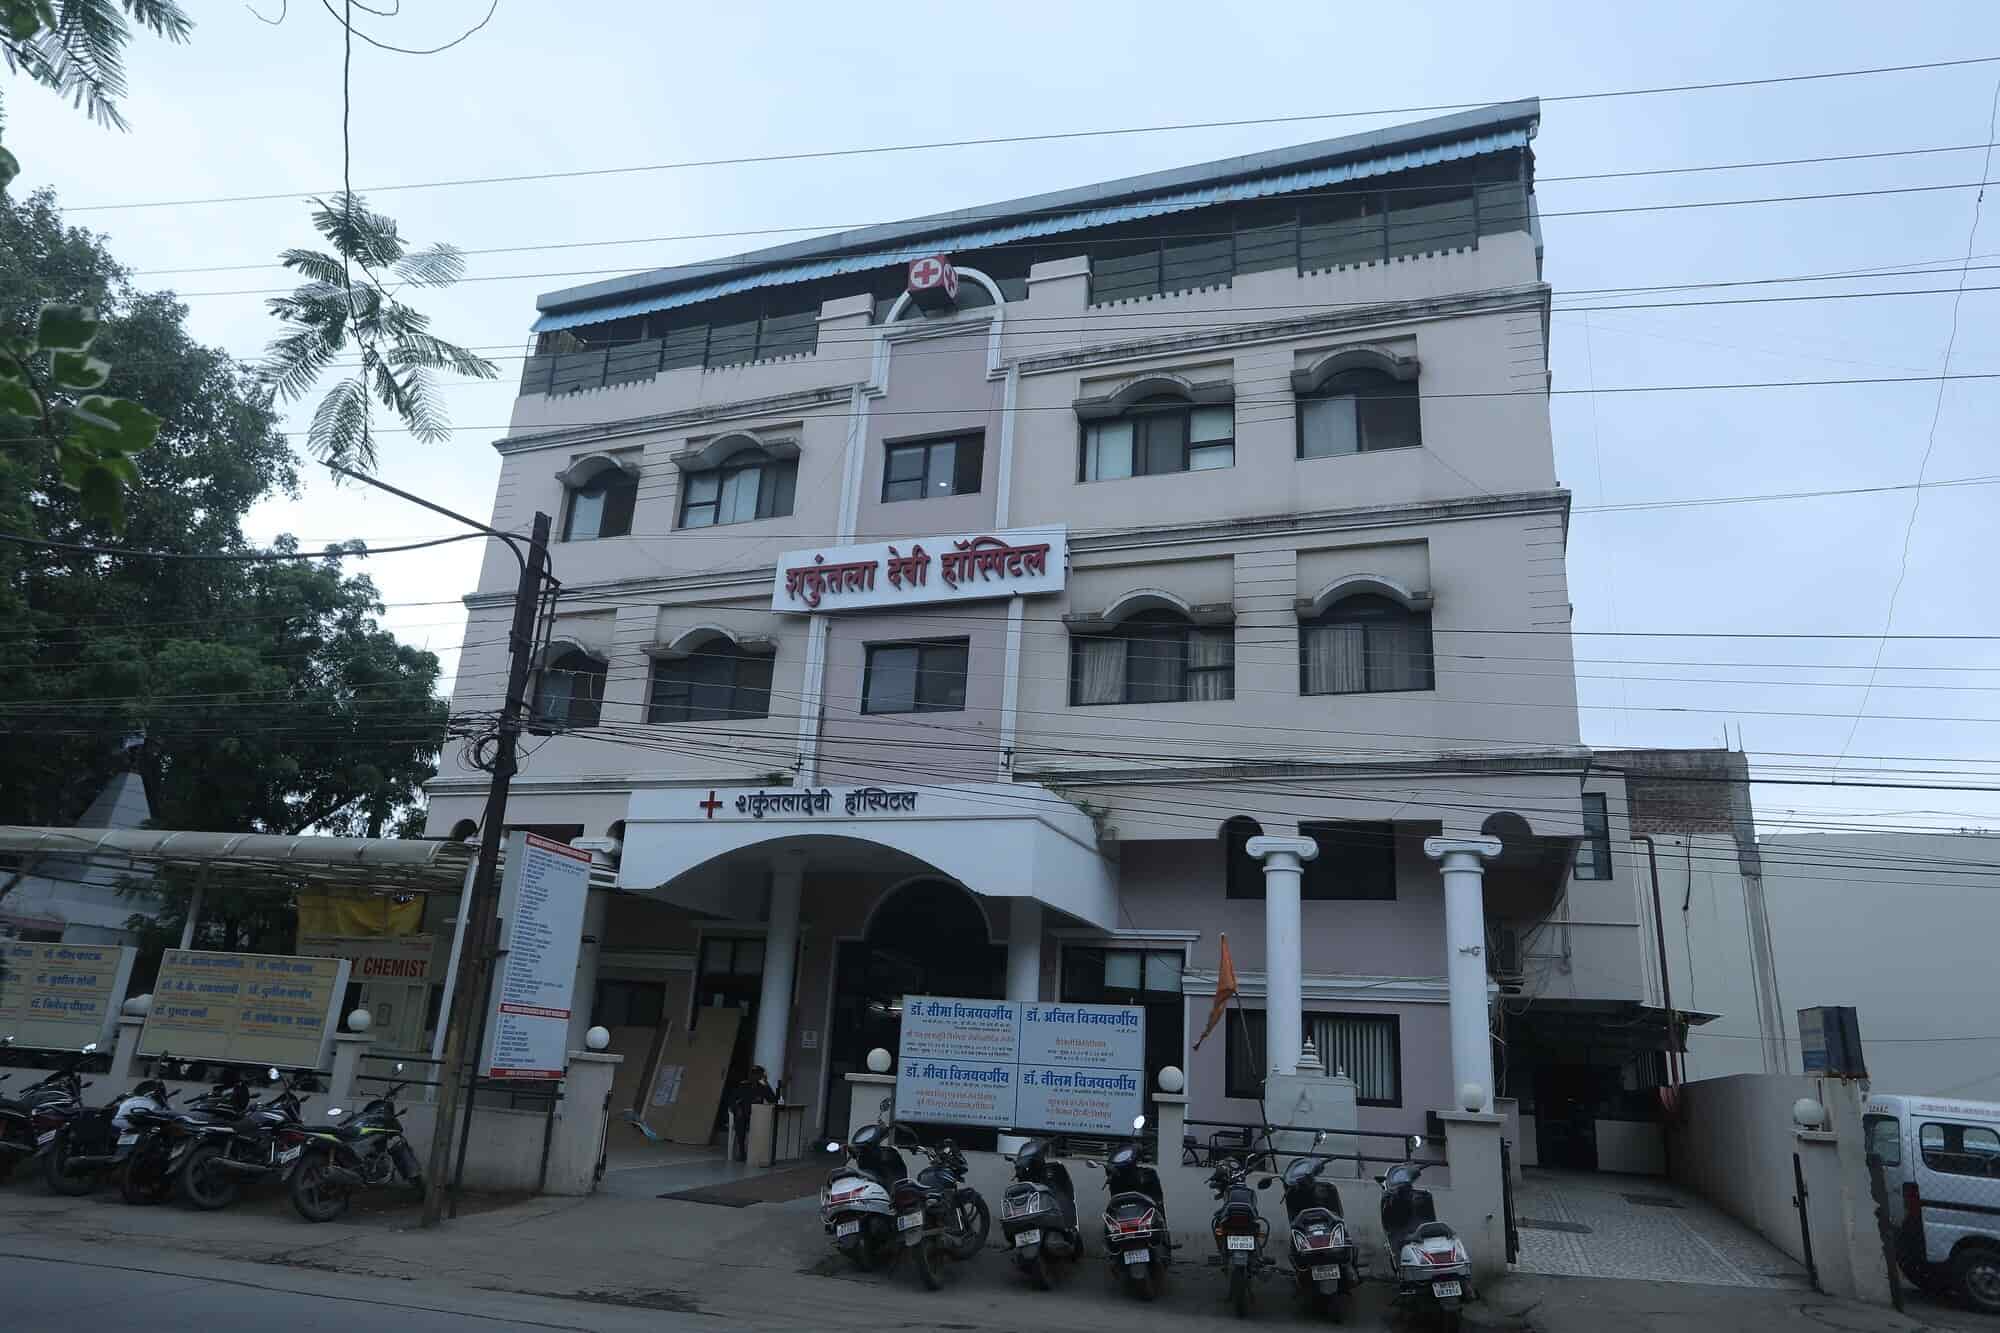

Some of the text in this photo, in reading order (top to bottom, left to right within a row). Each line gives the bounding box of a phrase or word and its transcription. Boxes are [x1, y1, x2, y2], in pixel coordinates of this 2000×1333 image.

[785, 536, 1050, 608] शकुंतला देवी हॉस्पिटल
[735, 786, 918, 818] शकुंतलादेवी हॉस्पिटल
[362, 957, 428, 977] CHEMIST
[910, 1002, 923, 1017] डॉ.
[1026, 1008, 1040, 1023] डॉ.
[1044, 1007, 1075, 1024] अनिल
[905, 1063, 920, 1078] डॉ.
[1023, 1071, 1038, 1085] डॉ.
[1041, 1071, 1072, 1087] नीलम
